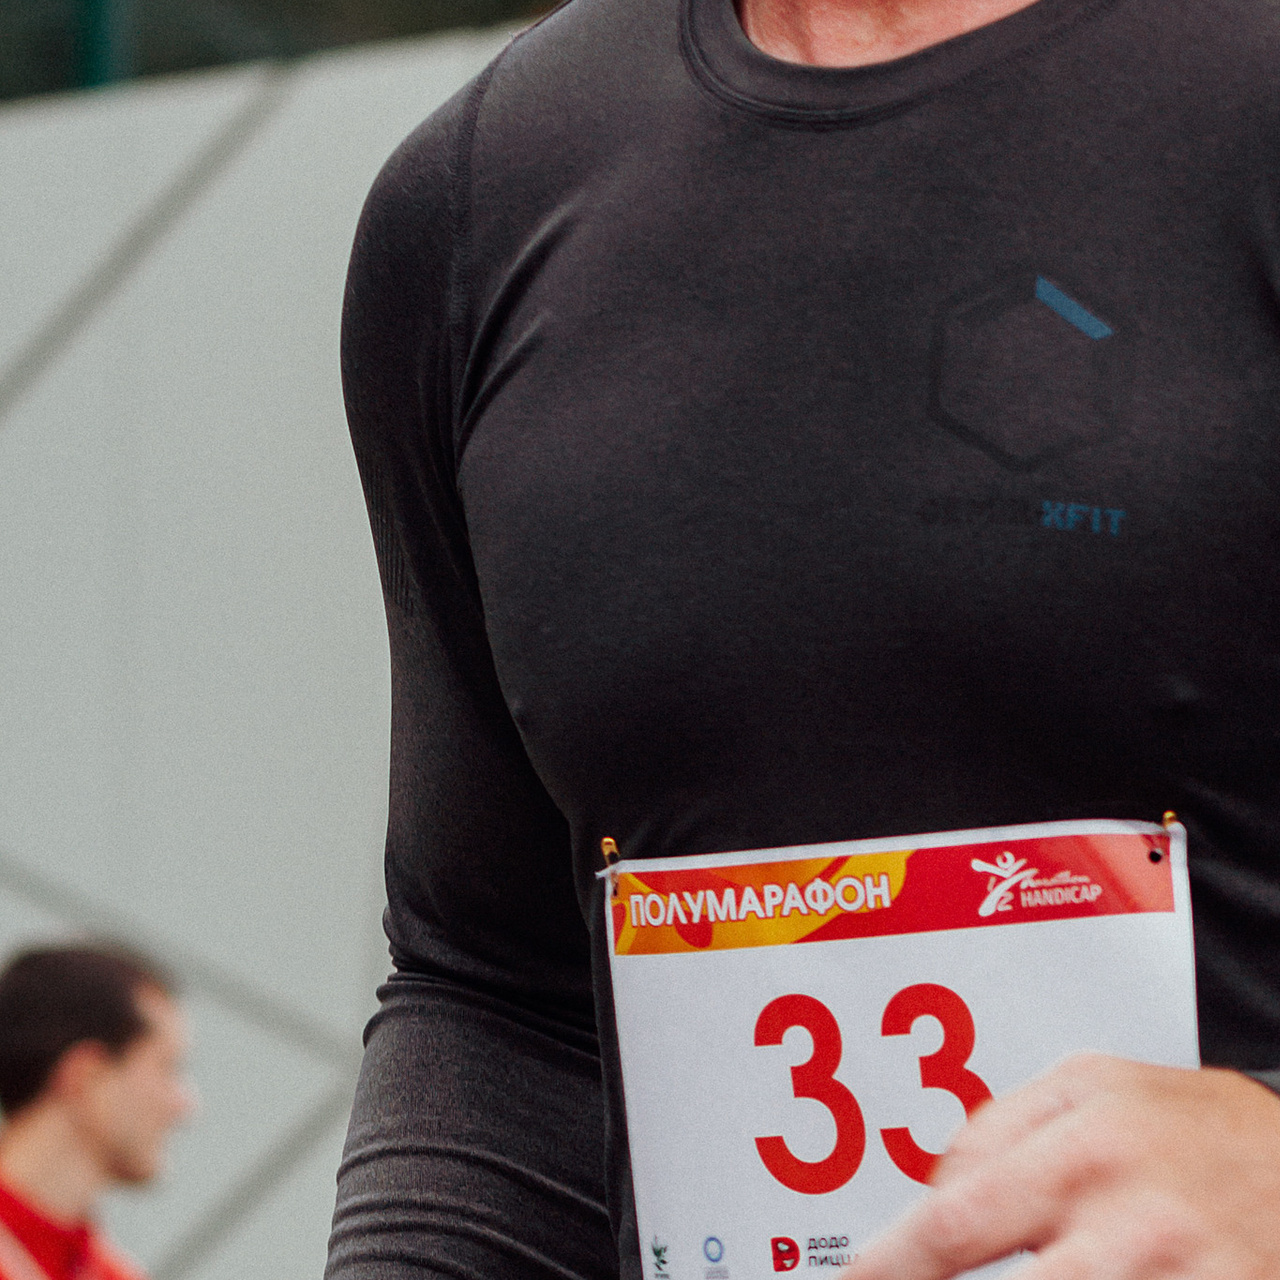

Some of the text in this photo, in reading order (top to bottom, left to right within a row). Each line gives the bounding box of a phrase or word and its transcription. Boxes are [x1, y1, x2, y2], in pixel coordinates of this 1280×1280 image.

[1041, 500, 1127, 537] XFIT
[629, 873, 891, 927] ПОЛУМАРАФОН
[1020, 884, 1103, 908] HANDICAP
[753, 982, 995, 1195] 33
